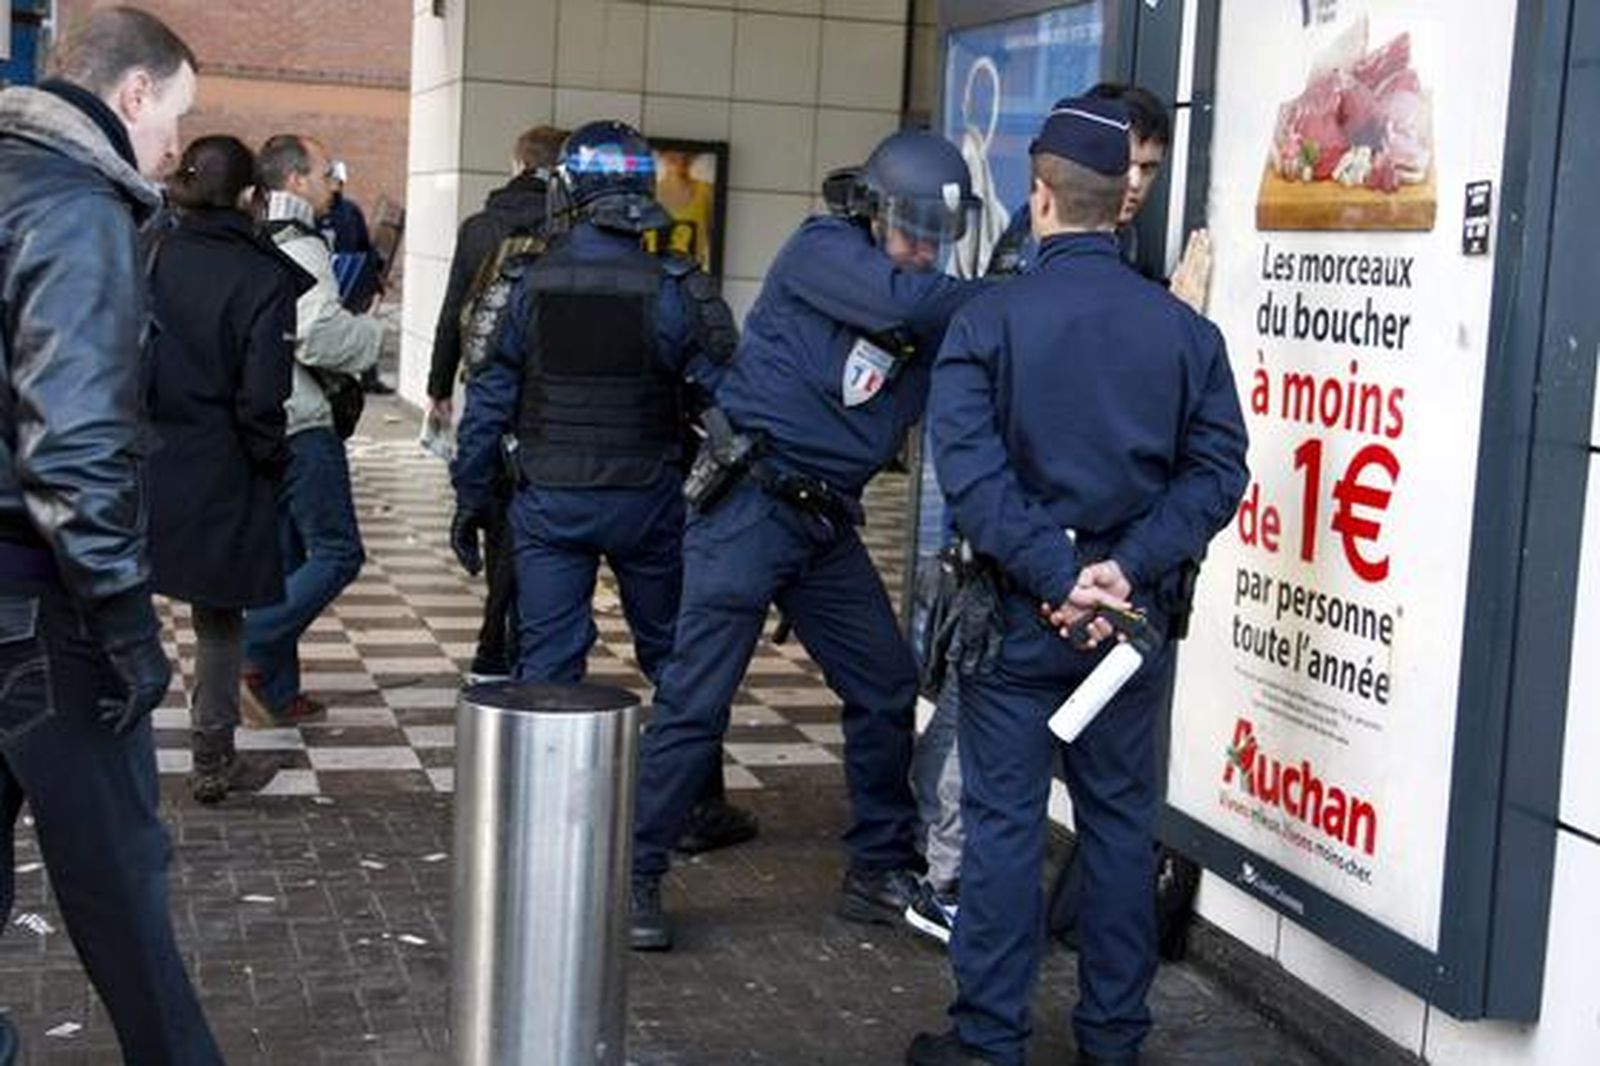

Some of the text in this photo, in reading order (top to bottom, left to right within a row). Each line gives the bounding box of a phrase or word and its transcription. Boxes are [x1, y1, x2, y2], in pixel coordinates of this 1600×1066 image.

[1262, 243, 1414, 288] Les morceaux
[1257, 290, 1410, 350] du boucher
[1251, 350, 1405, 439] à moins
[1237, 437, 1401, 583] de 1€
[1235, 567, 1273, 606] par
[1233, 614, 1291, 668] toute
[1293, 630, 1391, 705] l'année
[1222, 718, 1378, 856] Auchan
